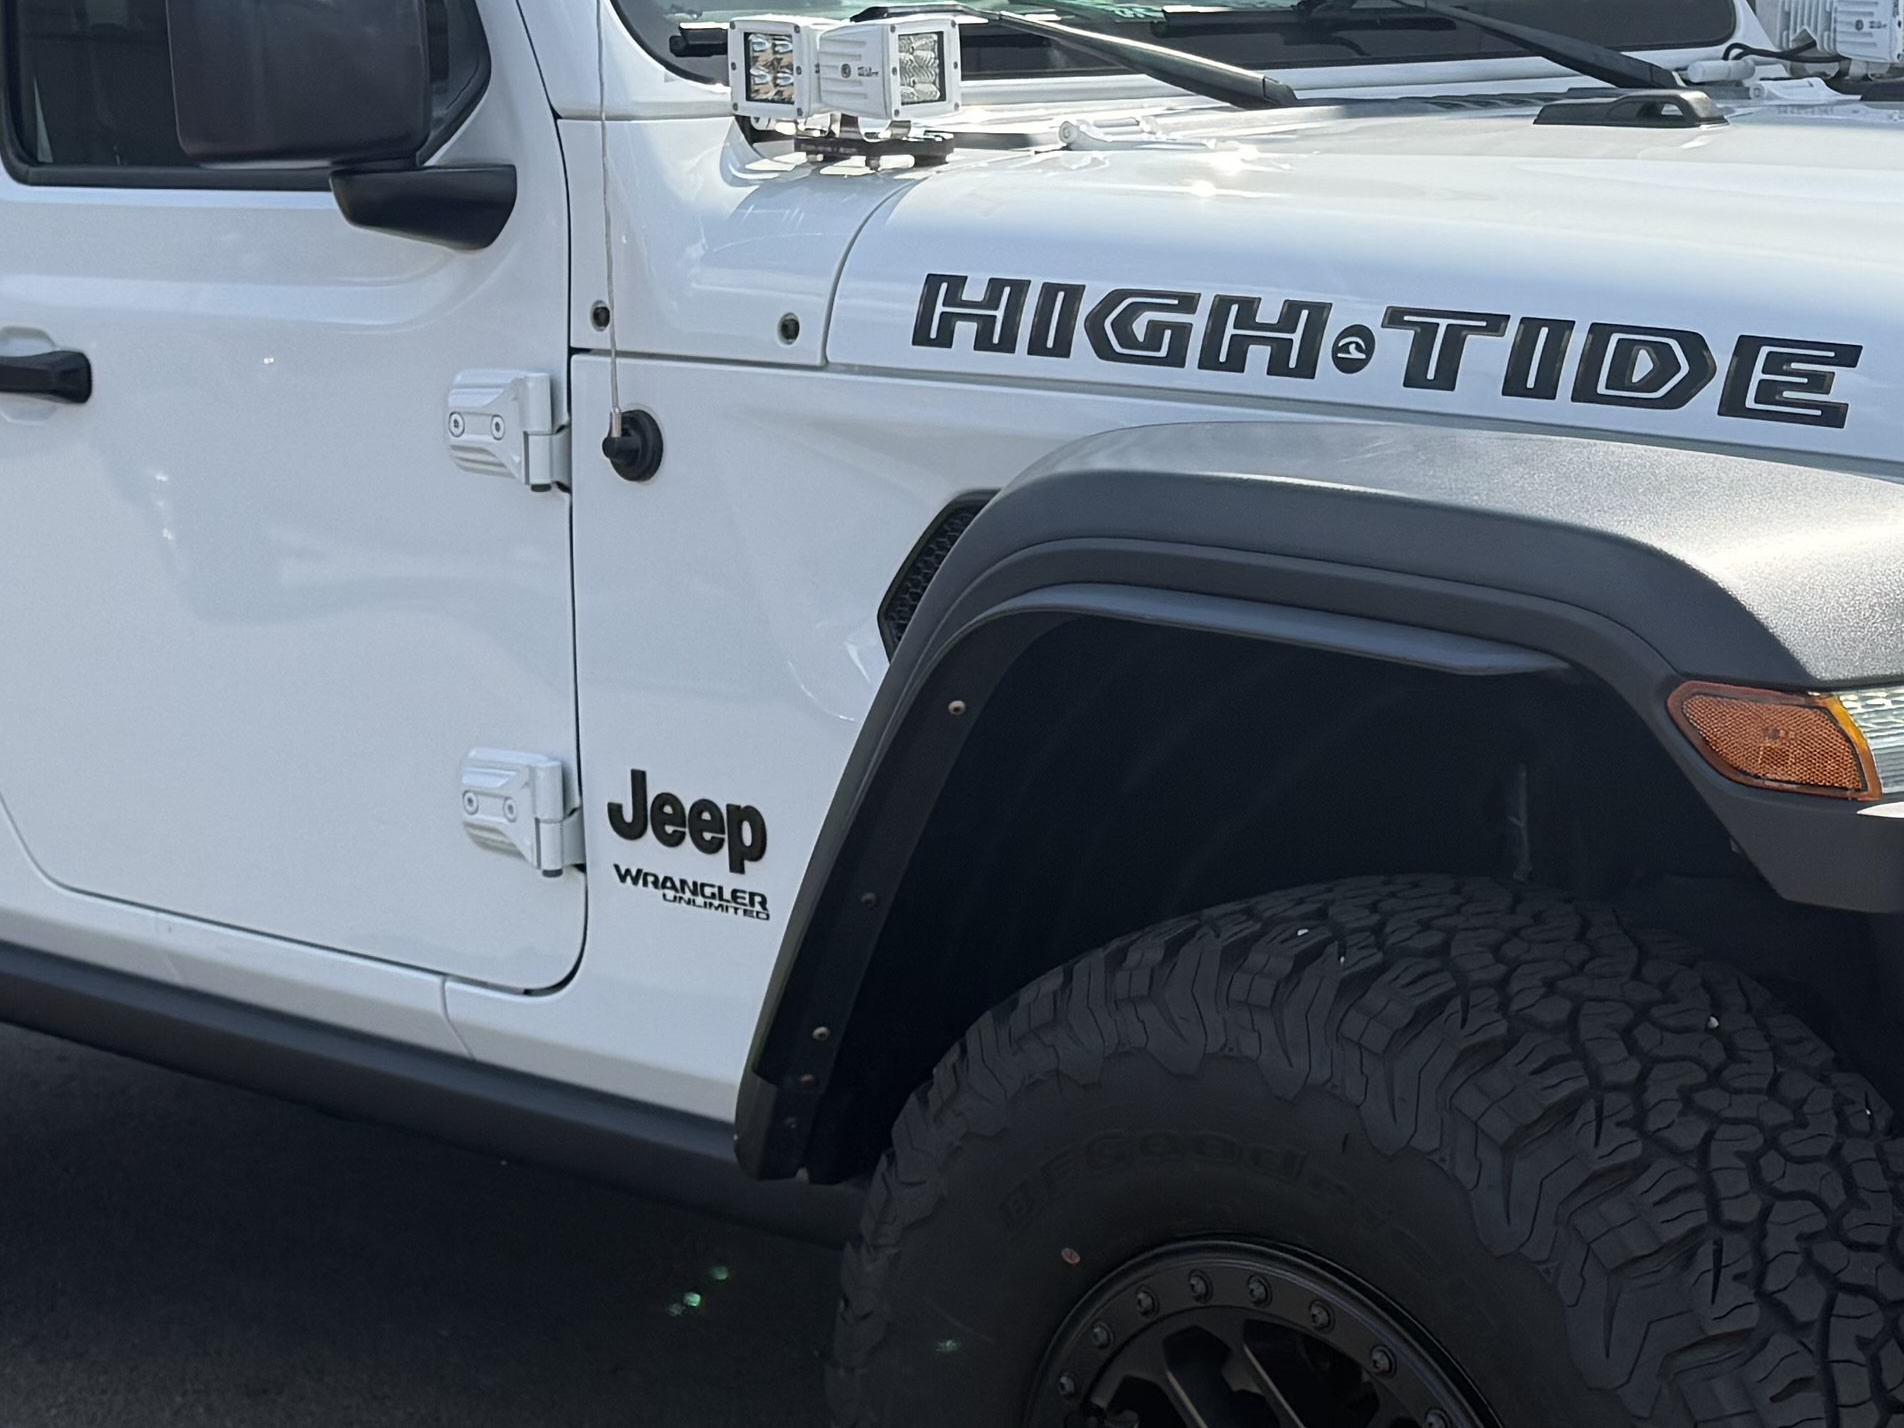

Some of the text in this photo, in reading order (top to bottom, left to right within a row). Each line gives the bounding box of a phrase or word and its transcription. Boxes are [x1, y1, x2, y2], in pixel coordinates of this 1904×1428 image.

[911, 272, 1864, 429] HIGH TIDE
[607, 768, 767, 875] Jeep
[613, 863, 770, 912] WRANGLER
[662, 892, 770, 921] UNLIMITED
